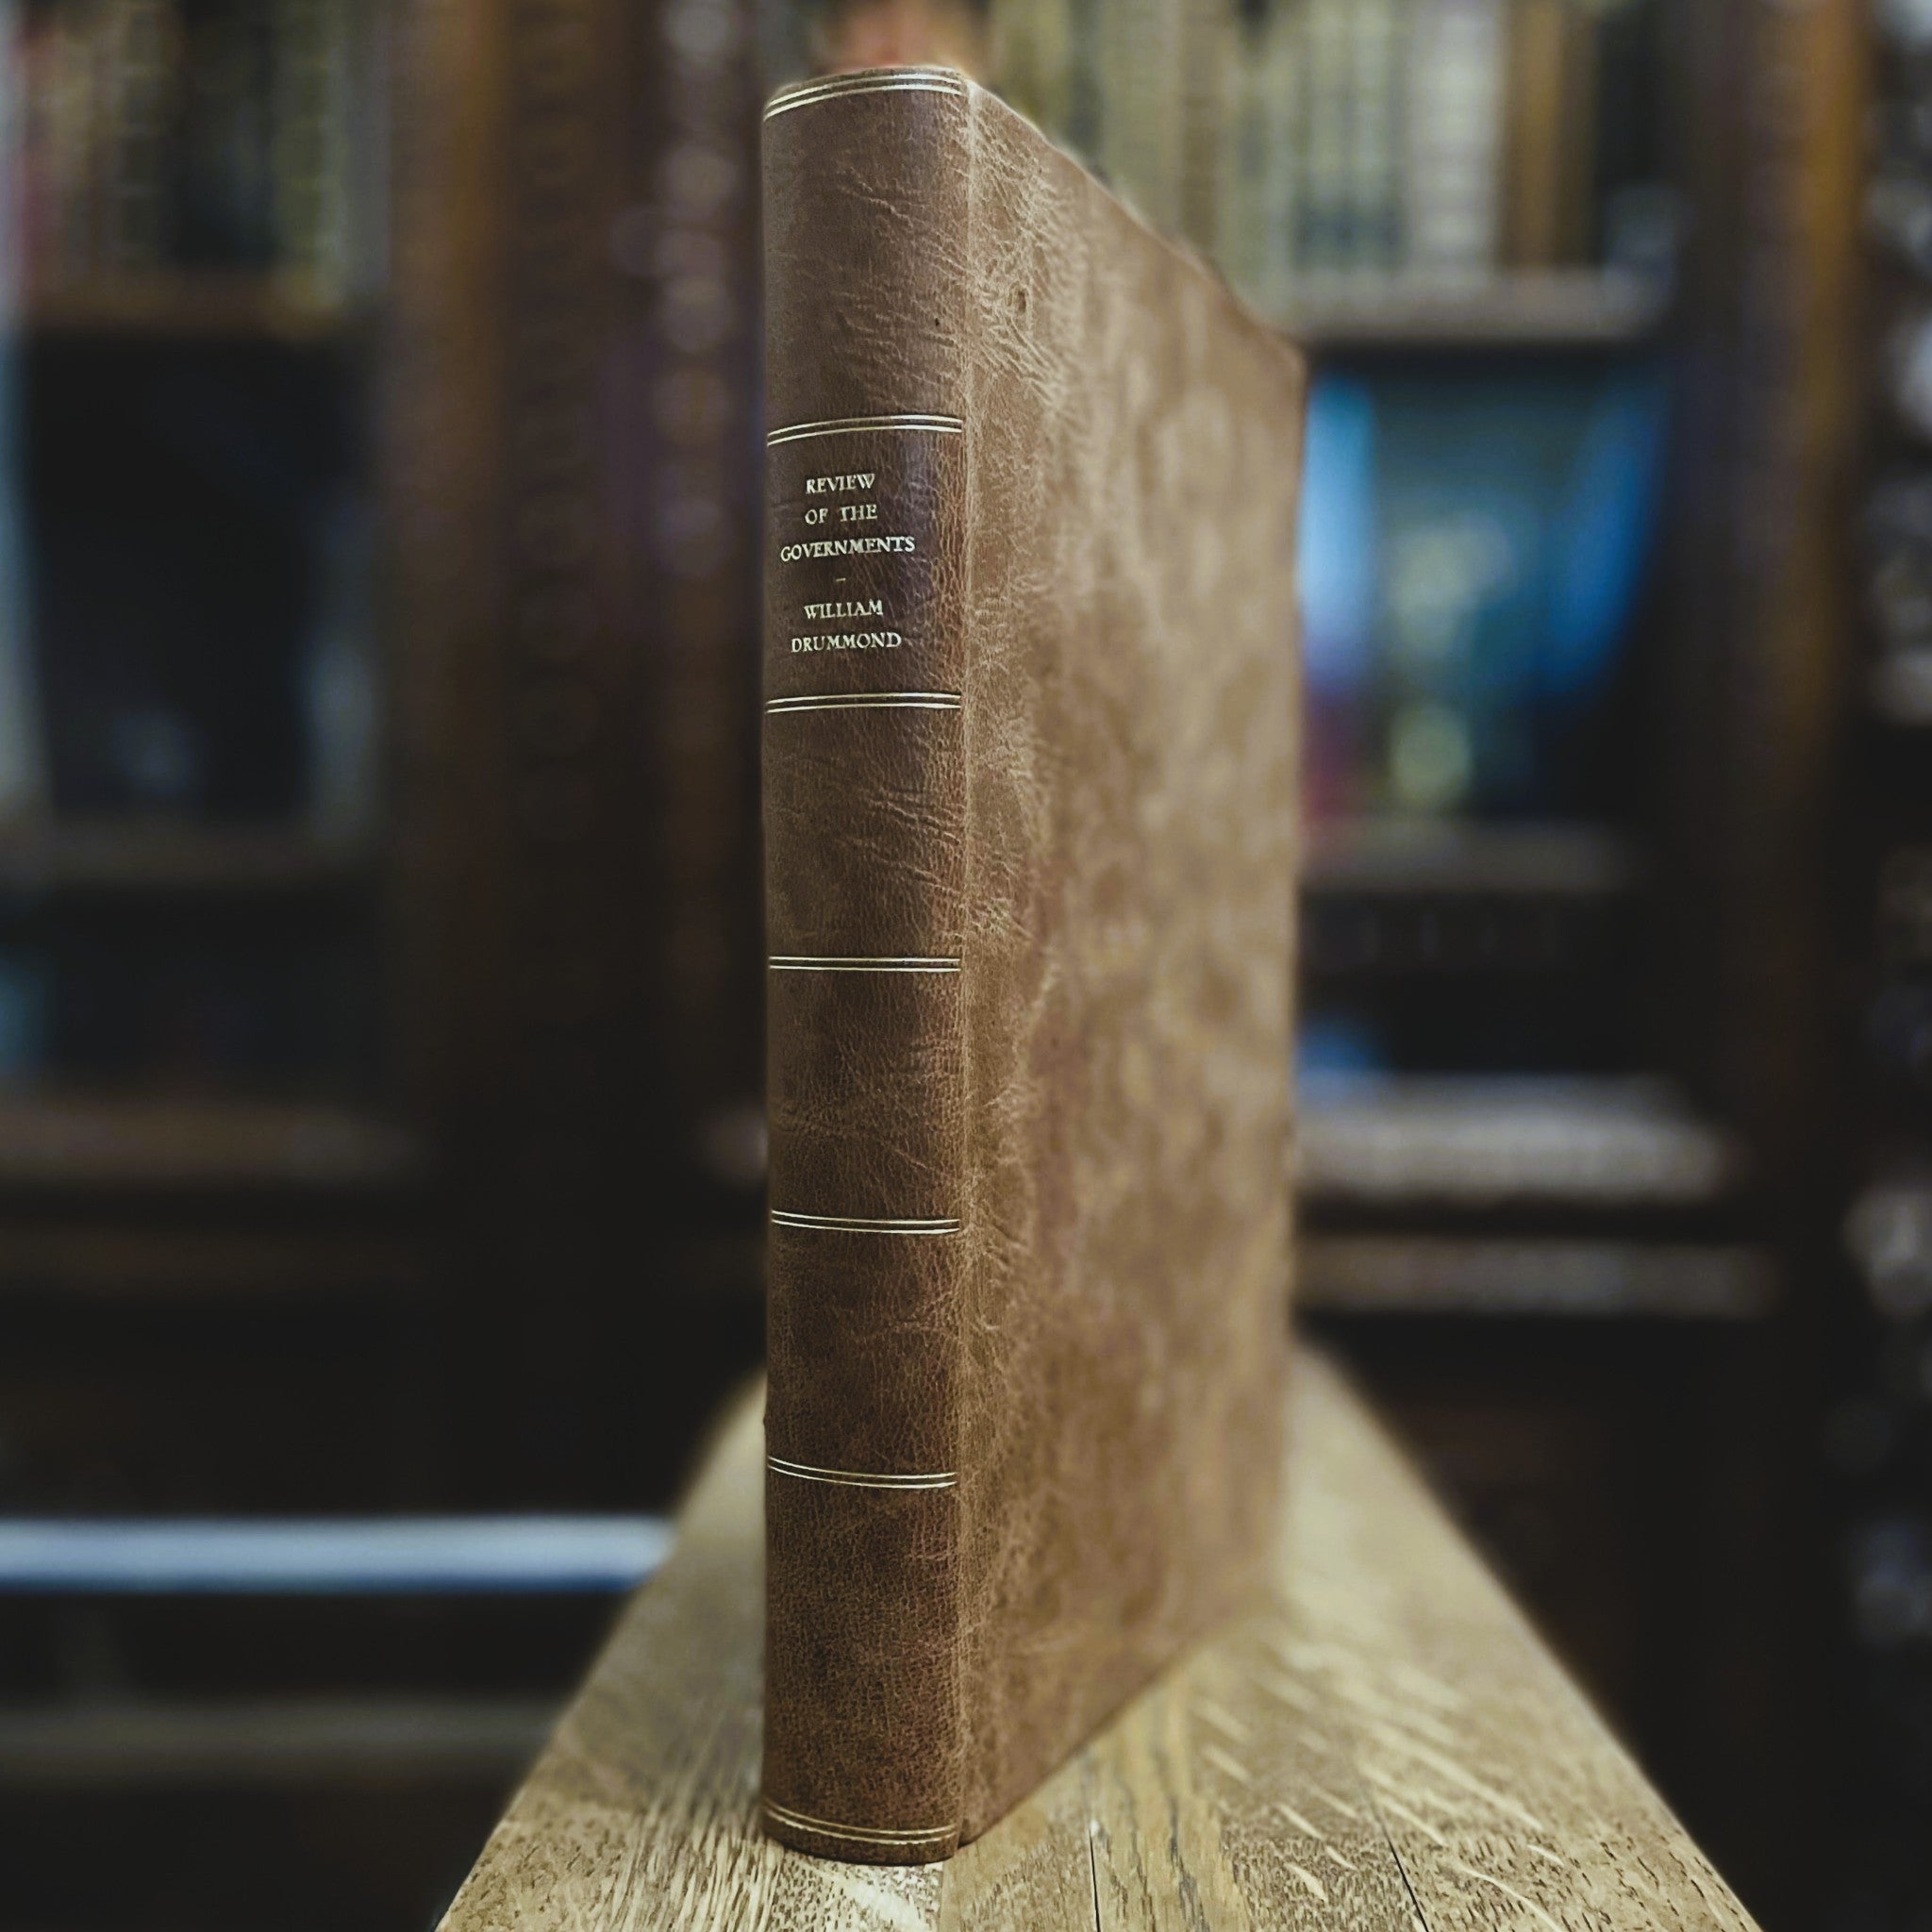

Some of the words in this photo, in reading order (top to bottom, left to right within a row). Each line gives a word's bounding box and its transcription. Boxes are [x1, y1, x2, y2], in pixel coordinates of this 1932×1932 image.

[806, 474, 875, 494] REVIEW
[805, 508, 828, 525] OF
[840, 504, 878, 522] THE
[780, 536, 915, 562] GOVERNMENTS
[804, 599, 883, 619] WILLIAM
[791, 632, 902, 653] DRUMMOND
